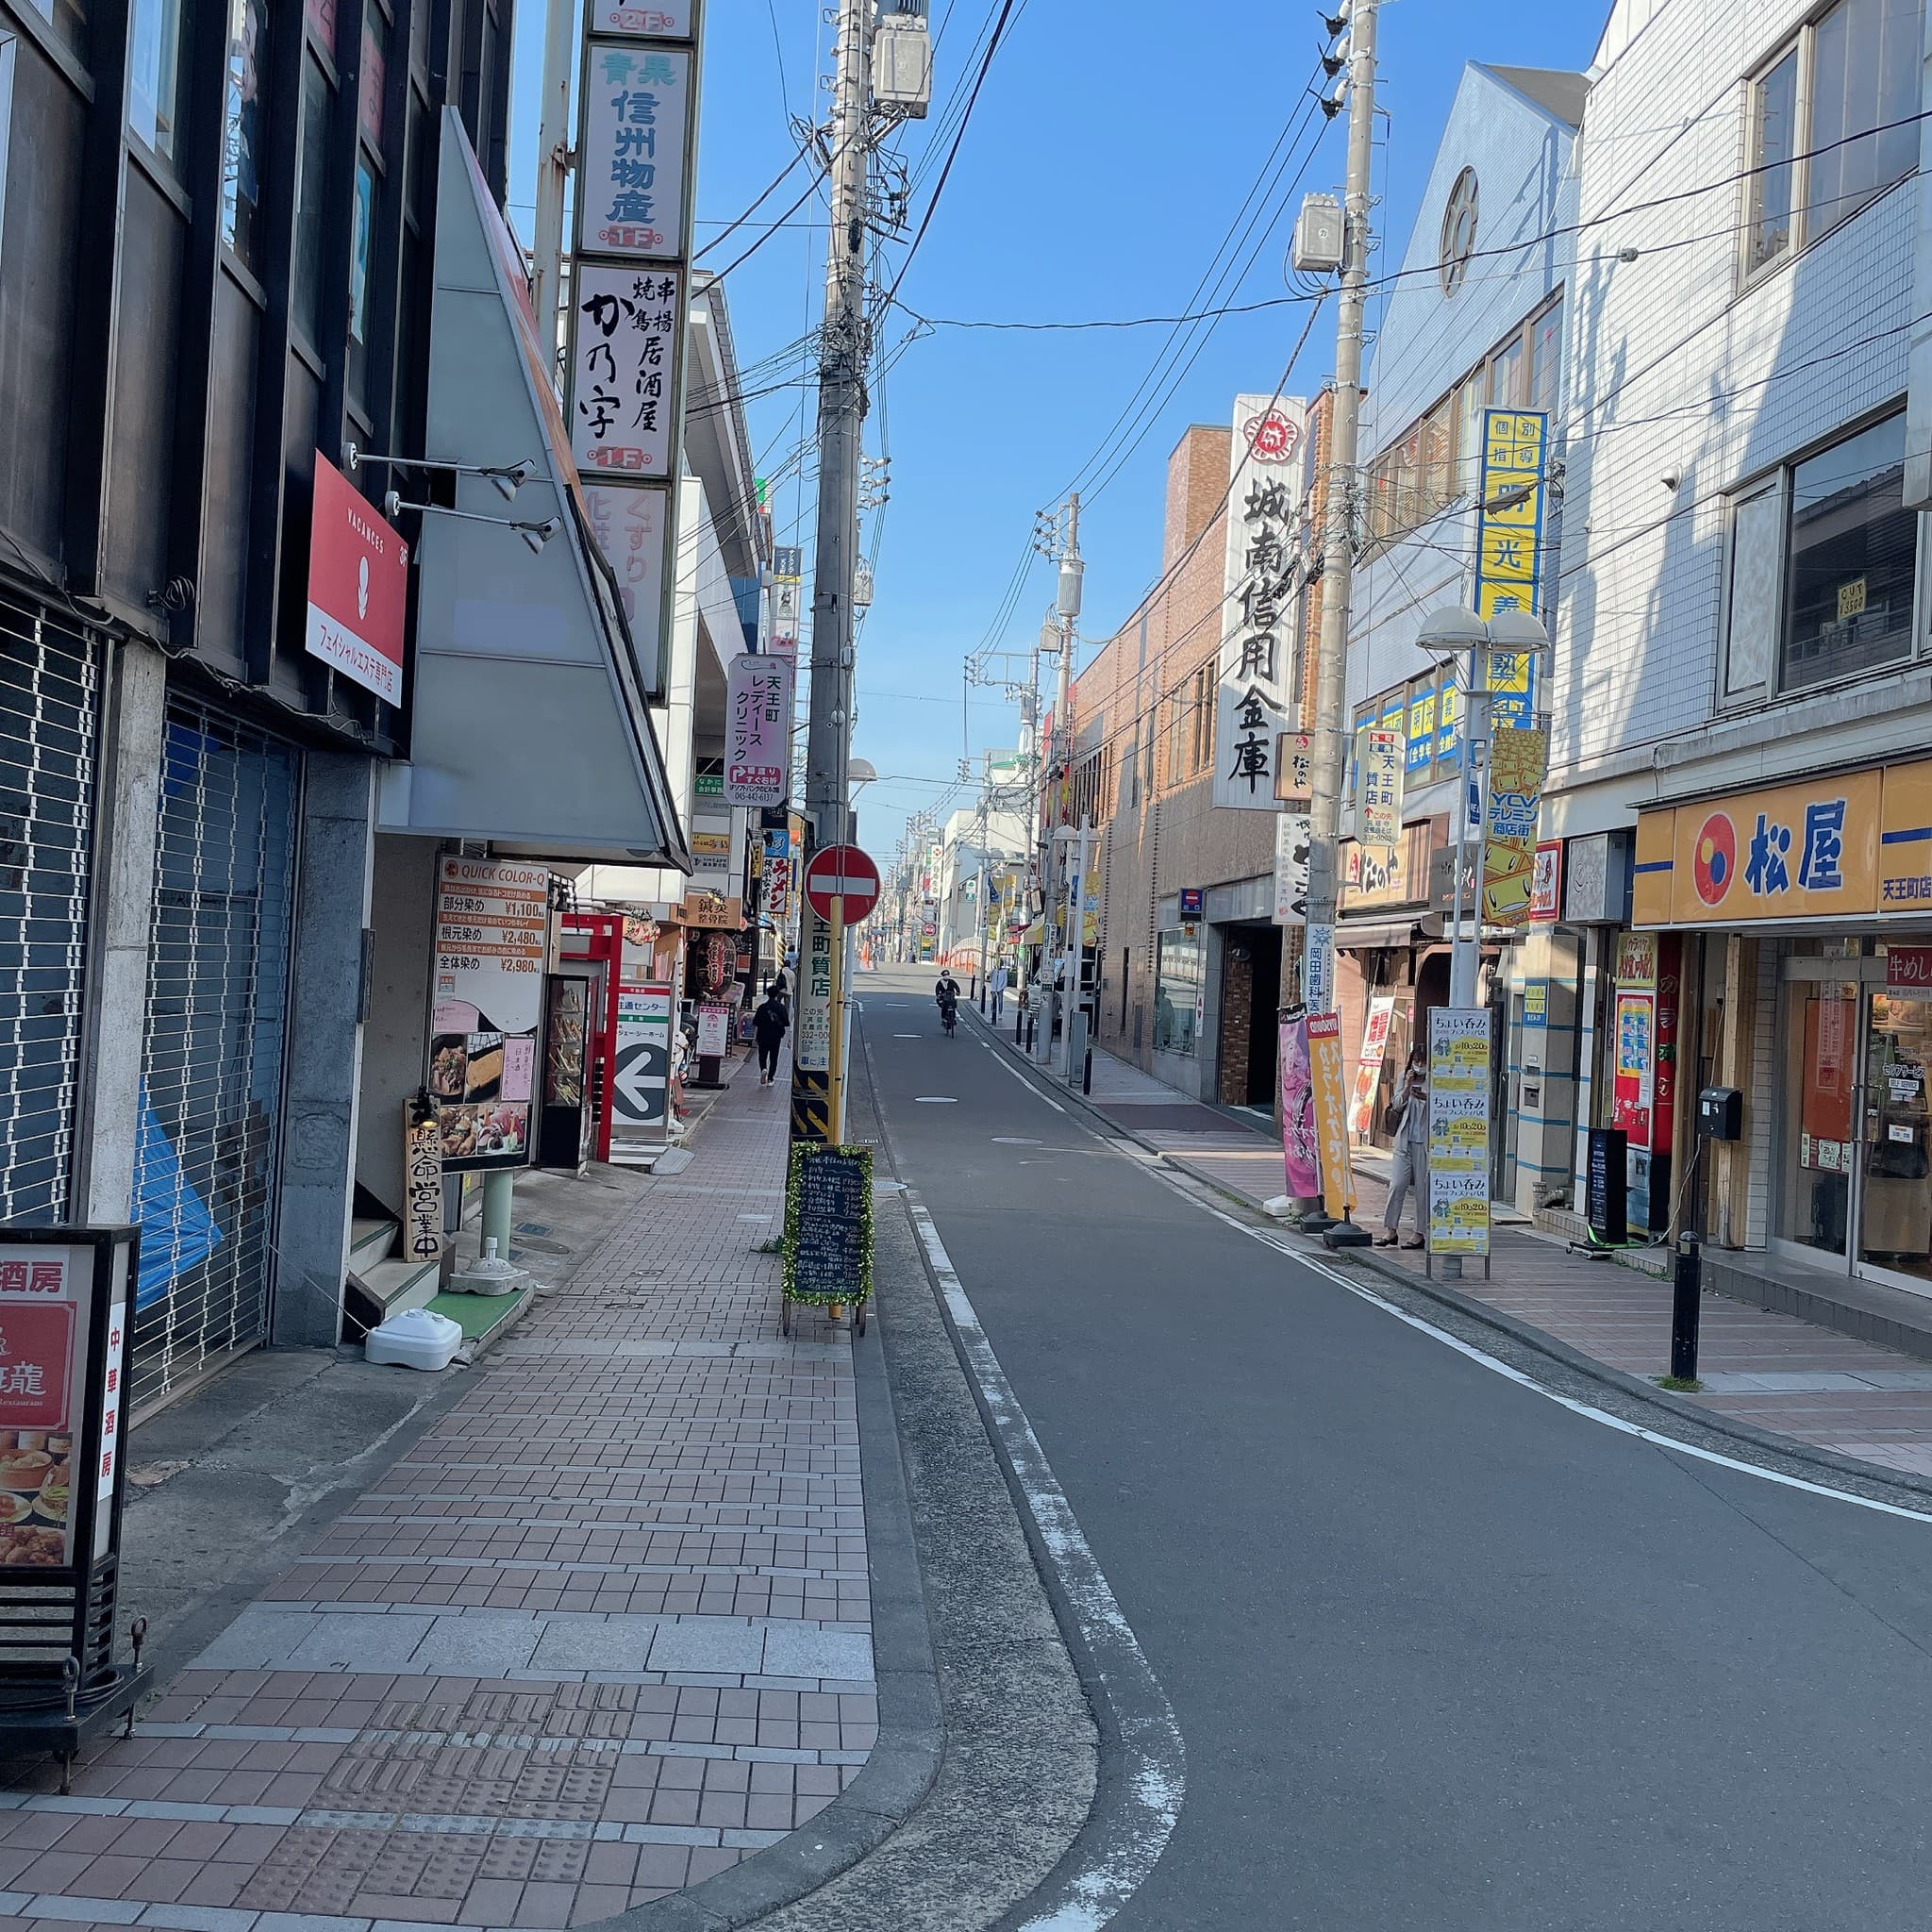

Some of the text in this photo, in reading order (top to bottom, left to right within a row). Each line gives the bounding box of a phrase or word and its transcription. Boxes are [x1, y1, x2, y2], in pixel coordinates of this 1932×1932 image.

[625, 11, 663, 31] 2F
[600, 52, 676, 86] 青果
[606, 90, 660, 224] 信州物産
[612, 227, 652, 248] 1F
[631, 275, 656, 332] 焼鳥
[654, 276, 675, 333] 串揚
[631, 336, 664, 432] 居酒屋
[1495, 421, 1535, 436] 個別
[604, 448, 638, 468] 1F
[1493, 447, 1533, 462] 指導
[347, 508, 385, 555] VACANCES
[625, 495, 652, 582] くすり
[1840, 583, 1862, 600] CUT
[1228, 475, 1290, 793] 城南信用金庫
[319, 625, 393, 693] フェイシャルエステ専門店
[749, 675, 765, 746] レディース
[766, 675, 781, 723] 天王町
[734, 691, 749, 761] クリニック
[1366, 772, 1378, 805] 質店
[1381, 755, 1394, 806] 天王町
[1491, 792, 1540, 808] YCV
[1488, 808, 1538, 823] テレミン
[1493, 823, 1530, 836] 商店街
[1744, 798, 1847, 896] 松屋
[461, 865, 545, 887] QUICK COLOR-Q
[770, 859, 788, 909] ラーメン
[1883, 875, 1932, 901] 天王町店
[443, 896, 539, 917] 部分染め ¥1,100
[698, 899, 728, 914] 鍼灸
[698, 913, 729, 925] 整骨院
[441, 926, 536, 945] 根元染め ¥2,480
[440, 955, 535, 974] 全体染め ¥2,980
[1890, 955, 1932, 981] 牛めし
[1308, 948, 1323, 1015] 岡田歯科医
[1436, 1018, 1487, 1029] ちょい呑み
[1434, 1097, 1485, 1109] ちょい呑み
[408, 1101, 441, 1257] 一懸命営業中
[1434, 1177, 1485, 1191] ちょい呑み
[0, 1260, 63, 1292] 酒房
[0, 1360, 46, 1396] 龍
